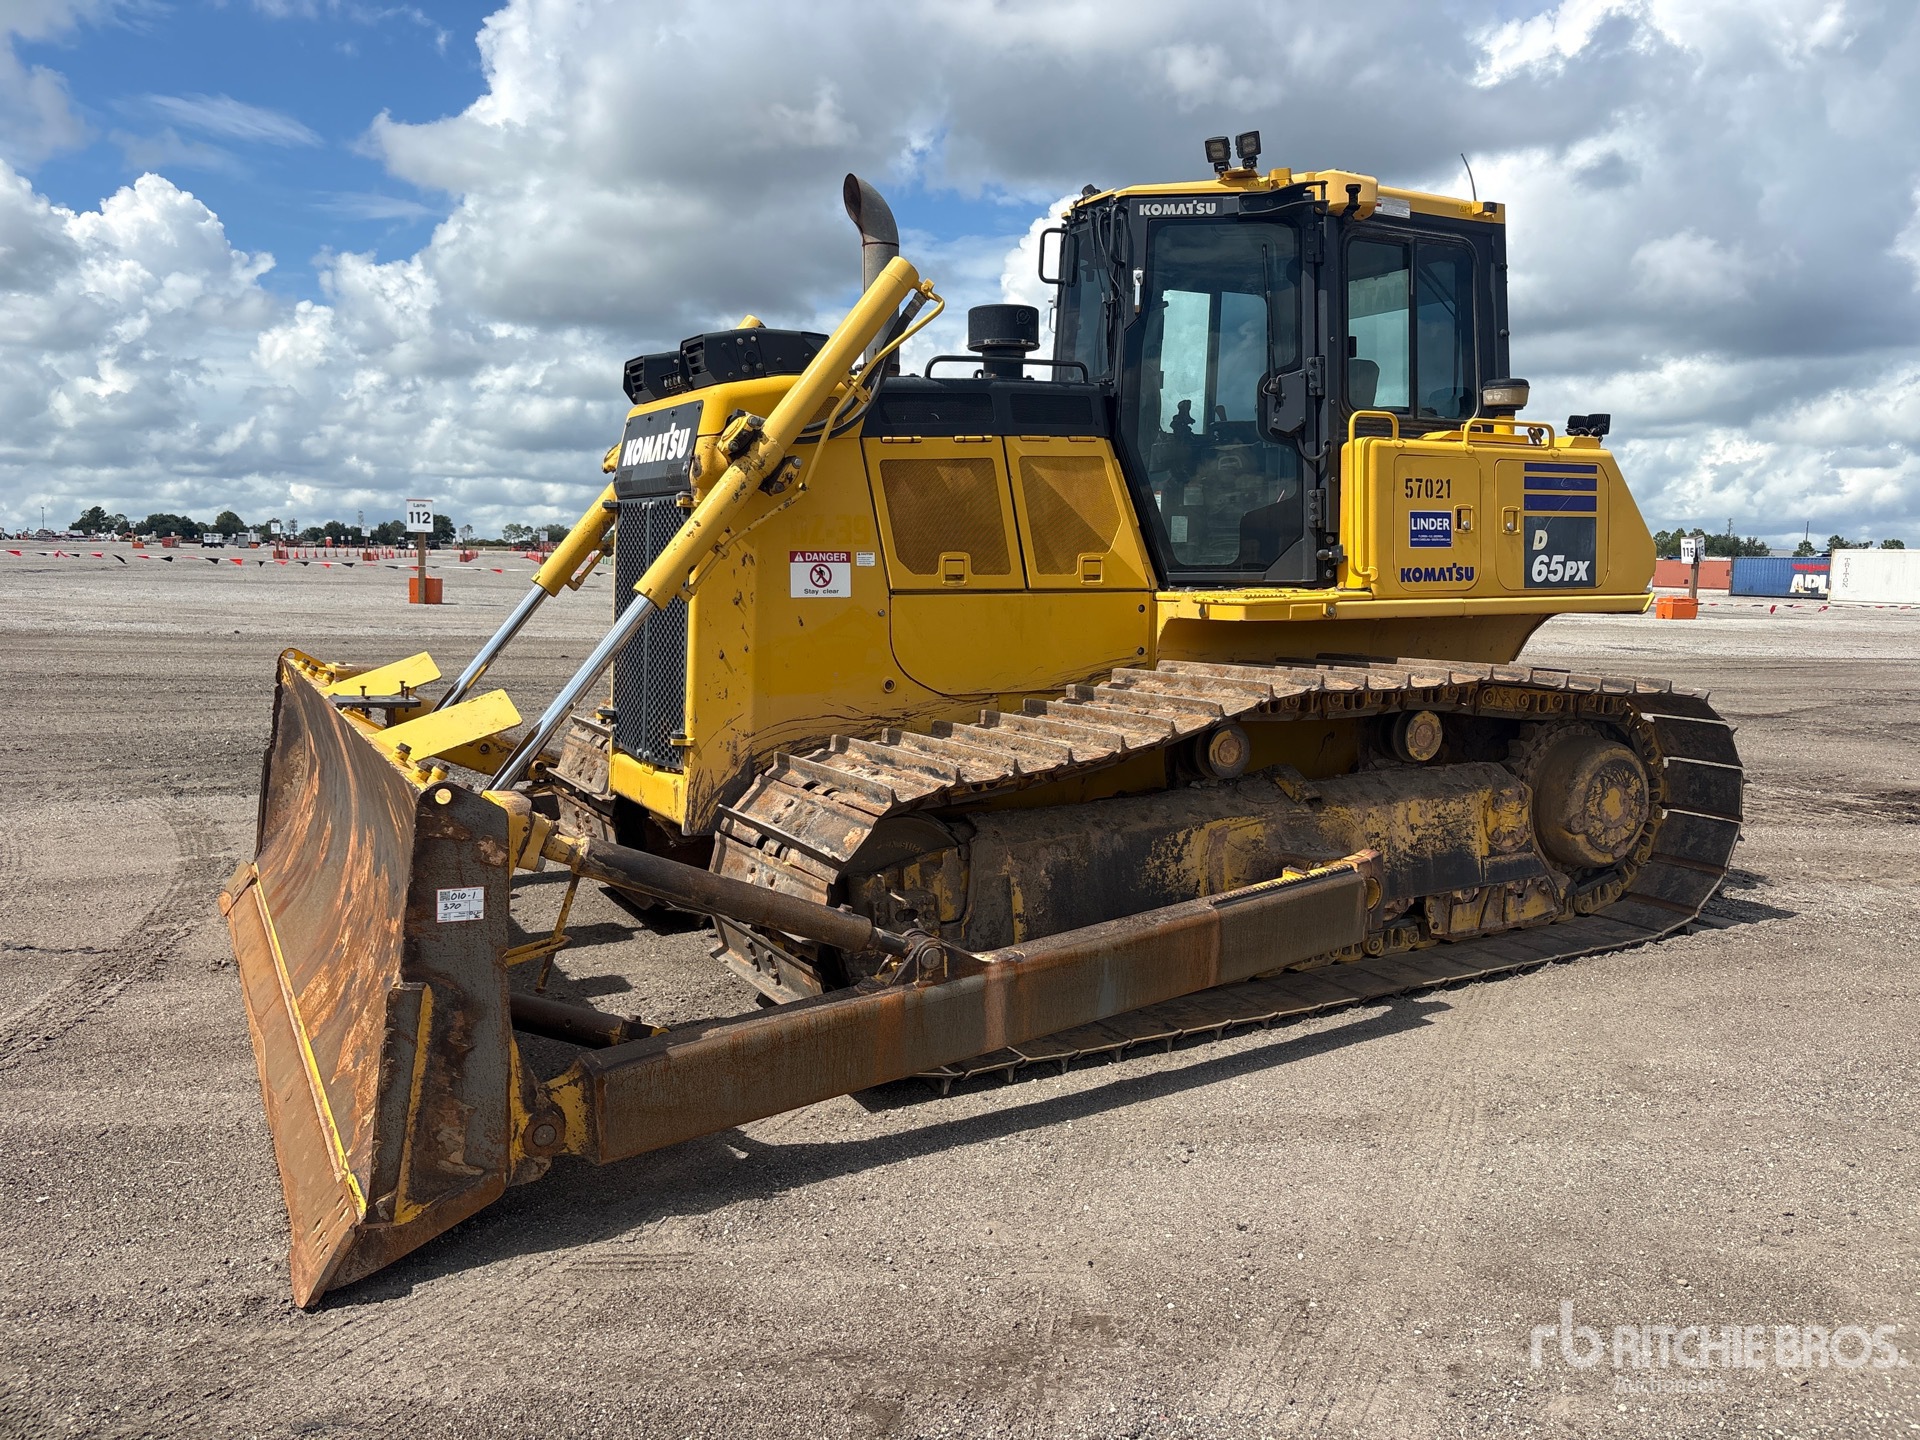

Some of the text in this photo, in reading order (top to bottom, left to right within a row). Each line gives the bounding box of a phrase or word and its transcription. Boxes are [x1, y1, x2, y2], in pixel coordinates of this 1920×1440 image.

[1139, 200, 1216, 216] KOMATSU
[622, 422, 691, 467] KOMATSU
[1404, 478, 1452, 499] 57021
[409, 512, 431, 524] 112
[1411, 518, 1450, 531] LINDER
[1532, 529, 1548, 551] D
[805, 552, 847, 562] DANGER
[1682, 547, 1695, 557] 115
[1400, 562, 1474, 583] KOMATSU
[1531, 554, 1591, 584] 65PX
[1842, 557, 1851, 588] TRITON
[804, 588, 819, 596] Stay
[1789, 574, 1828, 594] APL
[451, 892, 476, 900] 010-1
[443, 903, 461, 911] 370
